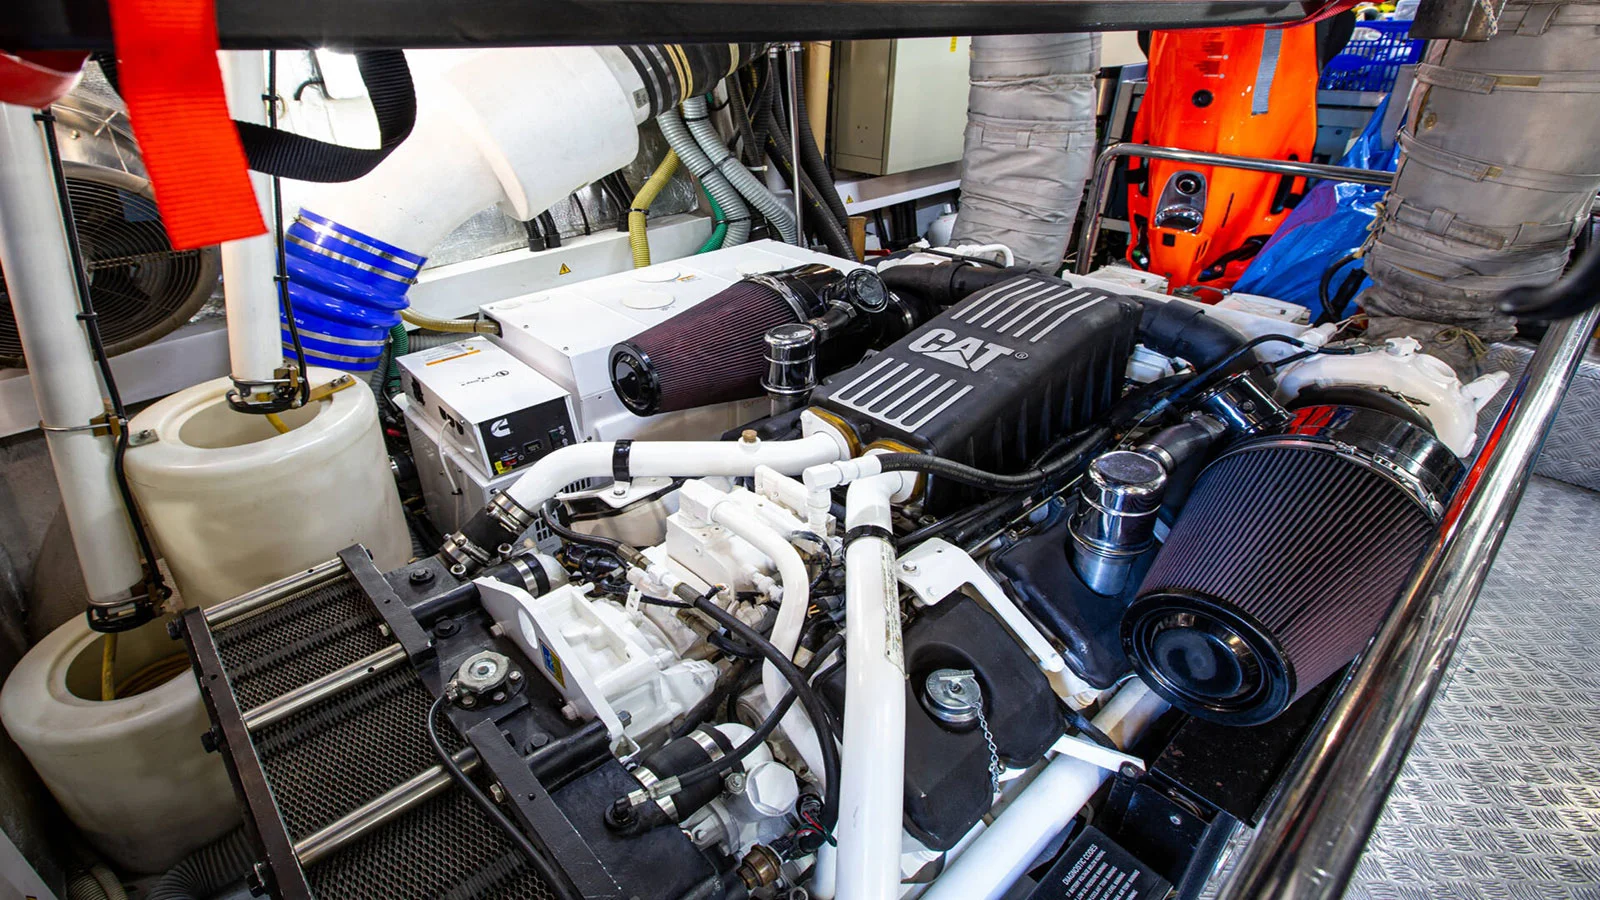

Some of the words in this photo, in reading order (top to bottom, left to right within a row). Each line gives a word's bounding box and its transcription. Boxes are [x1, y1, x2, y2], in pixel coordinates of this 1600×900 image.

[908, 328, 1015, 372] CAT
[1062, 857, 1087, 886] DIAGNOSTIC
[1082, 843, 1098, 861] CODES
